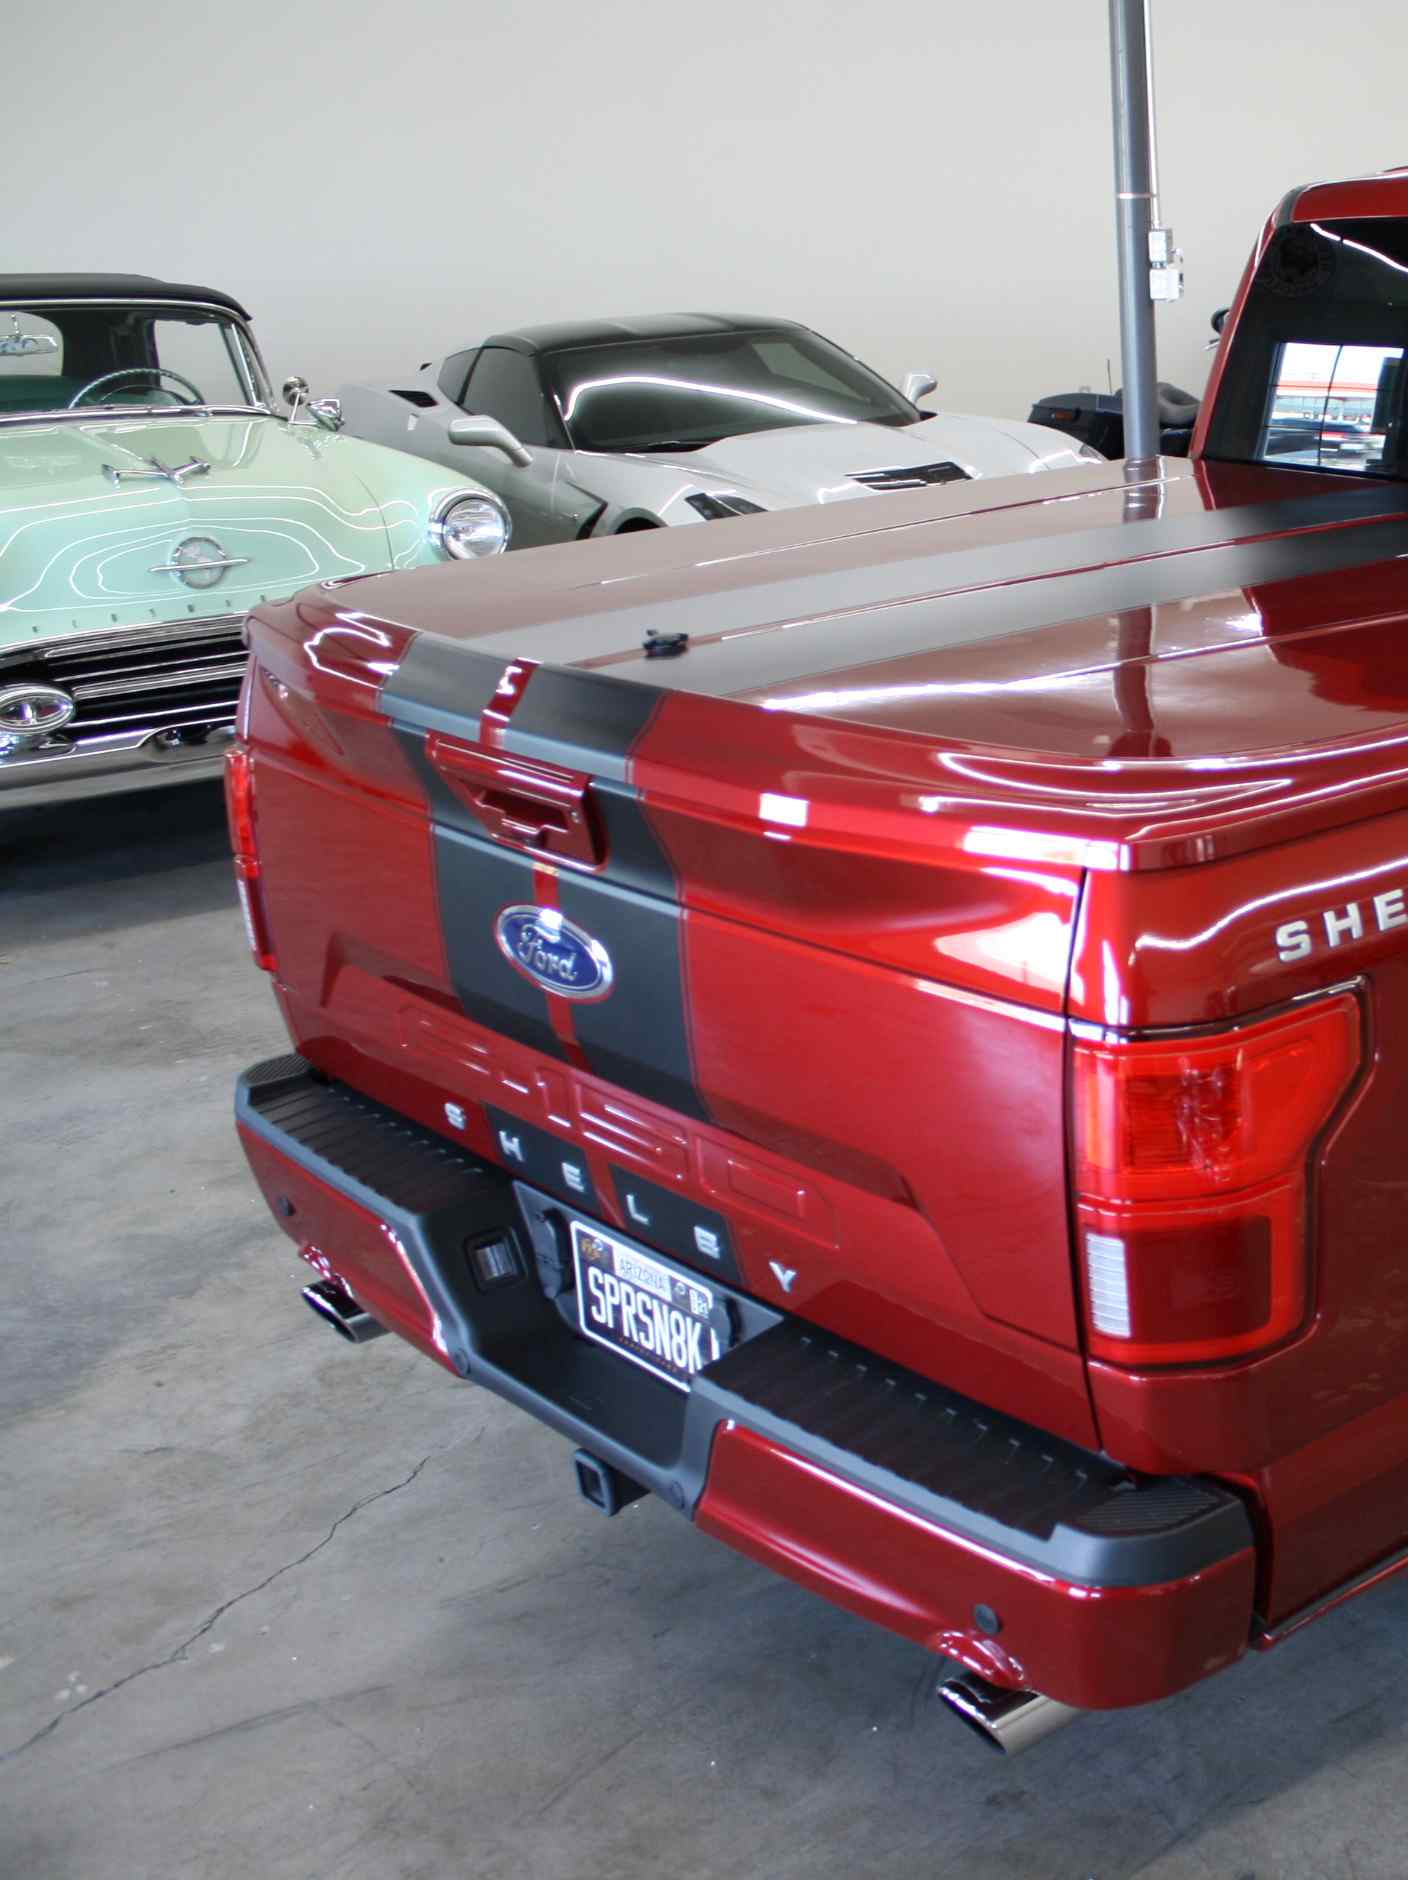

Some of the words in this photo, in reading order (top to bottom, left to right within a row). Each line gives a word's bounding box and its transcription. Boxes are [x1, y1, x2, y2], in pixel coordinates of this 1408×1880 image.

[518, 924, 579, 981] Ford
[444, 1102, 797, 1292] SHELBY
[588, 1266, 703, 1375] SPRSN8K
